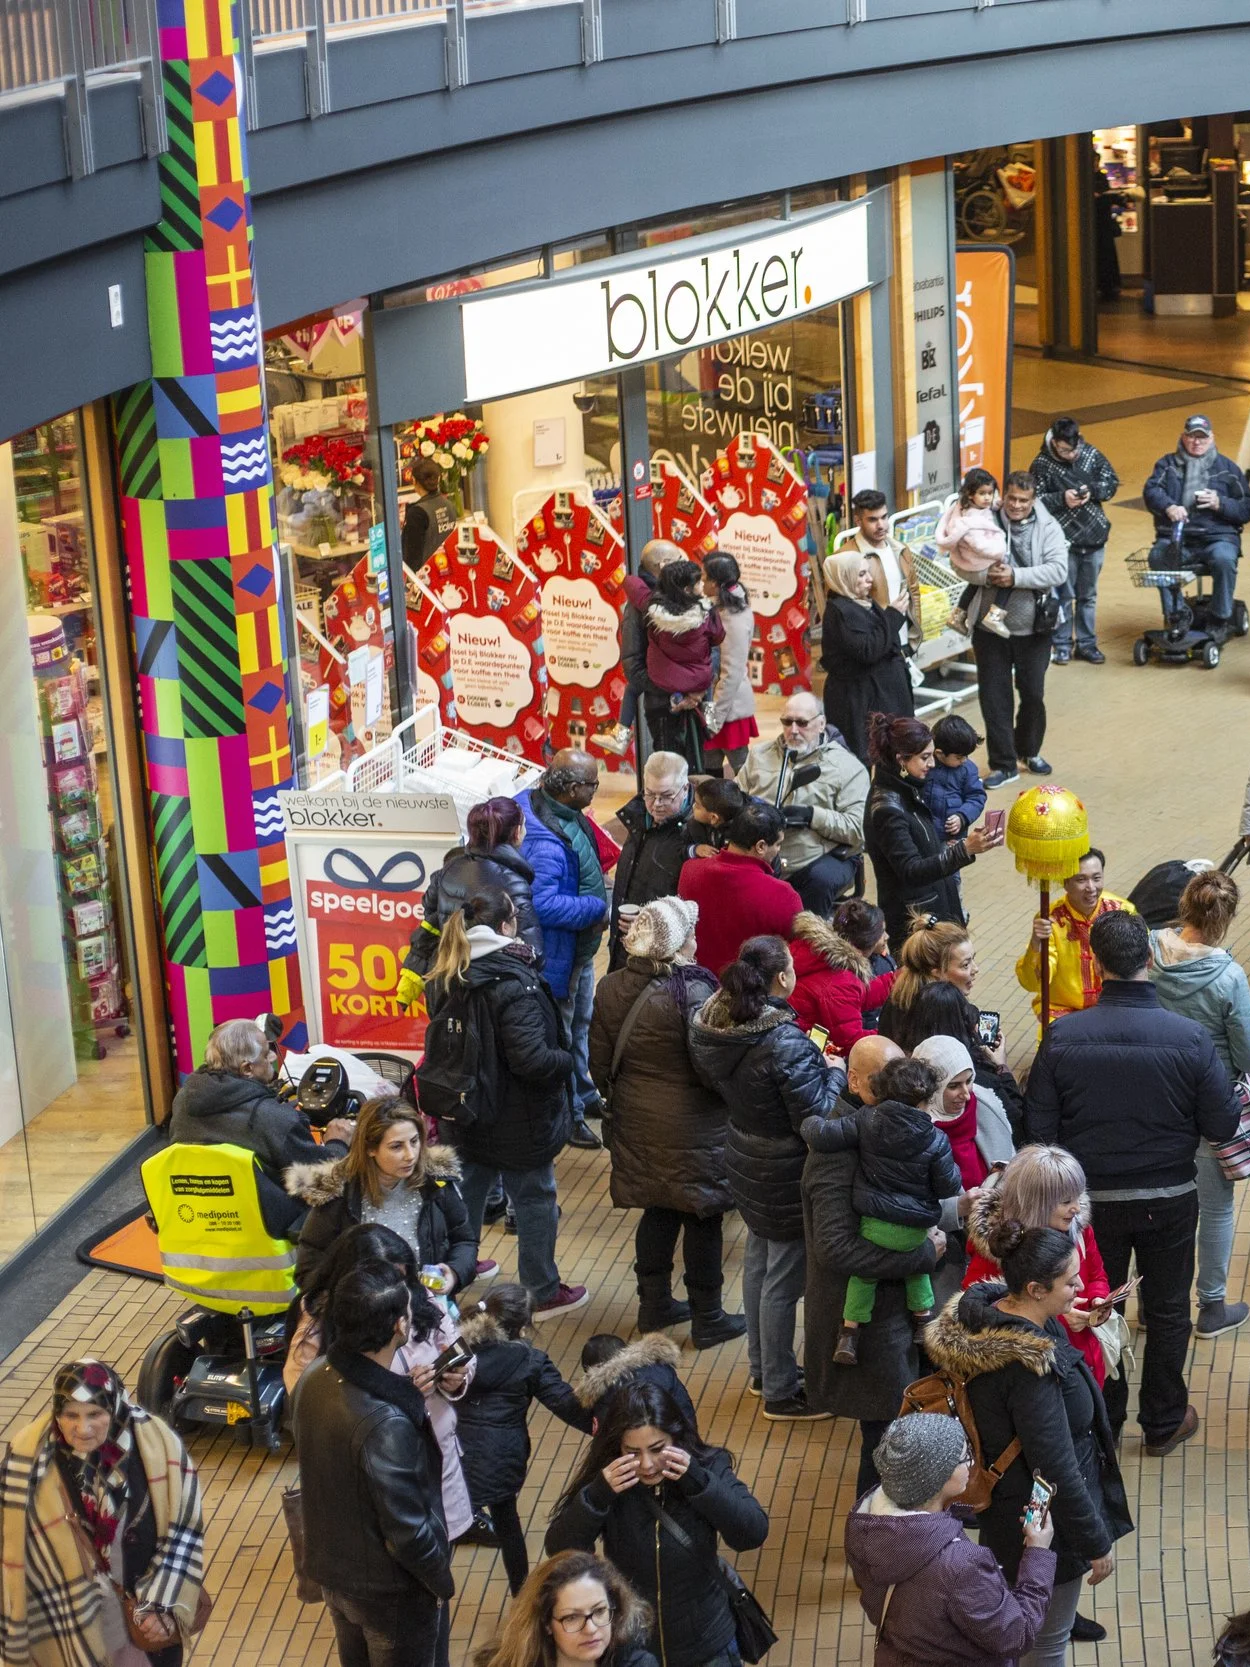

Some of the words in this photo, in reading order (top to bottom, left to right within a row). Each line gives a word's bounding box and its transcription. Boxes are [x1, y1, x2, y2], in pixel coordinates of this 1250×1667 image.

[734, 530, 772, 544] Nieuw!
[552, 595, 592, 610] Nieuw!
[571, 612, 596, 621] Blokker
[458, 633, 501, 648] Nieuw!
[451, 648, 467, 656] issel
[468, 650, 478, 658] bij
[479, 651, 506, 660] Blokker
[474, 660, 526, 671] waardepunten
[471, 669, 491, 677] koffie
[504, 671, 520, 679] thee
[284, 795, 339, 807] welkom
[343, 796, 360, 810] bij
[363, 796, 383, 809] de
[385, 797, 449, 810] nieuwste
[310, 890, 425, 922] speelgoe
[327, 943, 411, 992] 50
[329, 993, 427, 1018] KORTIN
[197, 1210, 240, 1220] medipoint
